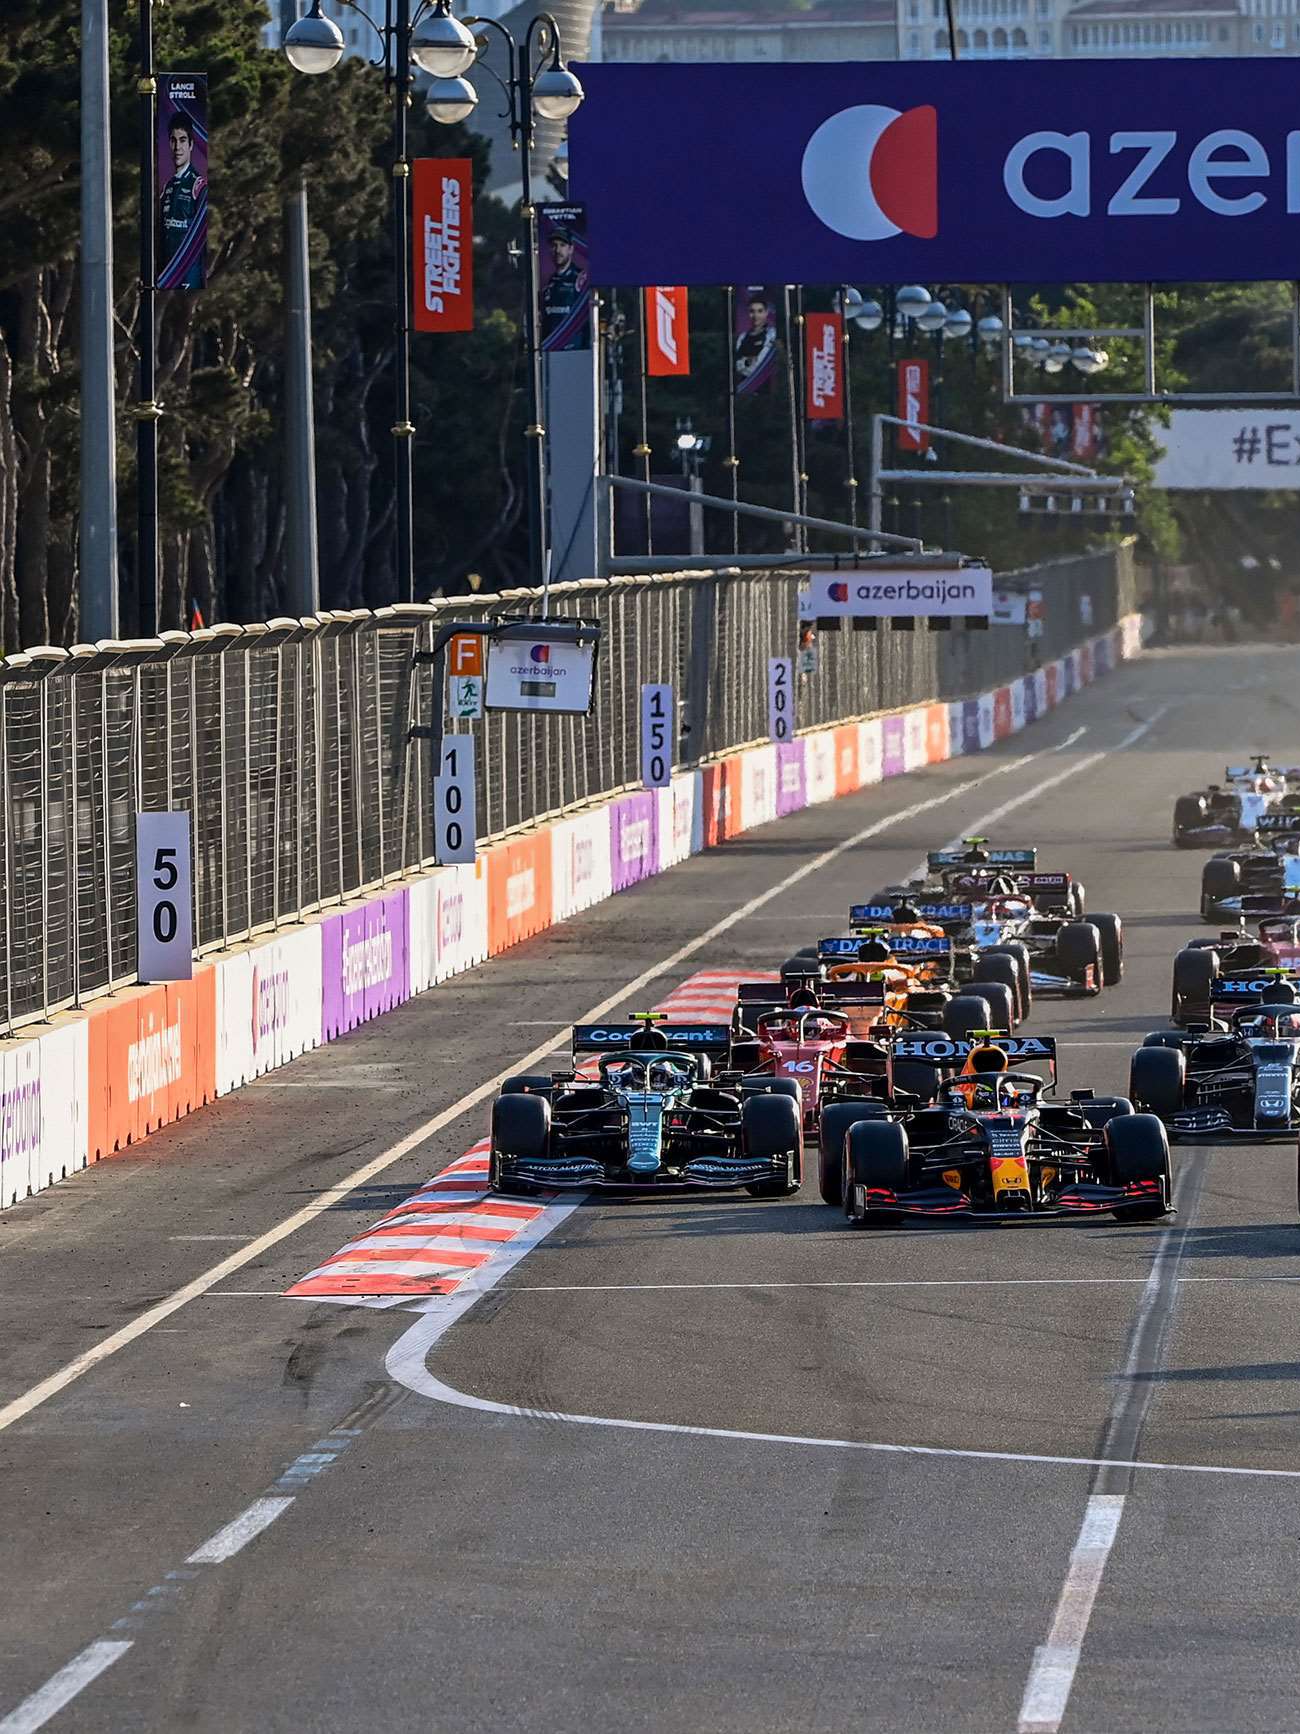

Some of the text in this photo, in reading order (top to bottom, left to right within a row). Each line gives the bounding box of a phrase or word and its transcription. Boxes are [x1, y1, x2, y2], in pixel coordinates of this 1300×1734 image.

[169, 91, 196, 99] STROLL
[424, 214, 443, 313] STREET
[442, 177, 461, 295] FIGHTERS
[857, 580, 976, 601] azerbaijan
[457, 639, 477, 670] F
[510, 665, 567, 678] azerbaijan
[651, 693, 666, 783] 150
[774, 662, 787, 739] 200
[445, 748, 462, 851] 100
[152, 847, 178, 943] 50
[839, 938, 948, 952] DATRACE
[782, 1060, 814, 1073] 16
[0, 1051, 41, 1162] zerbaijan
